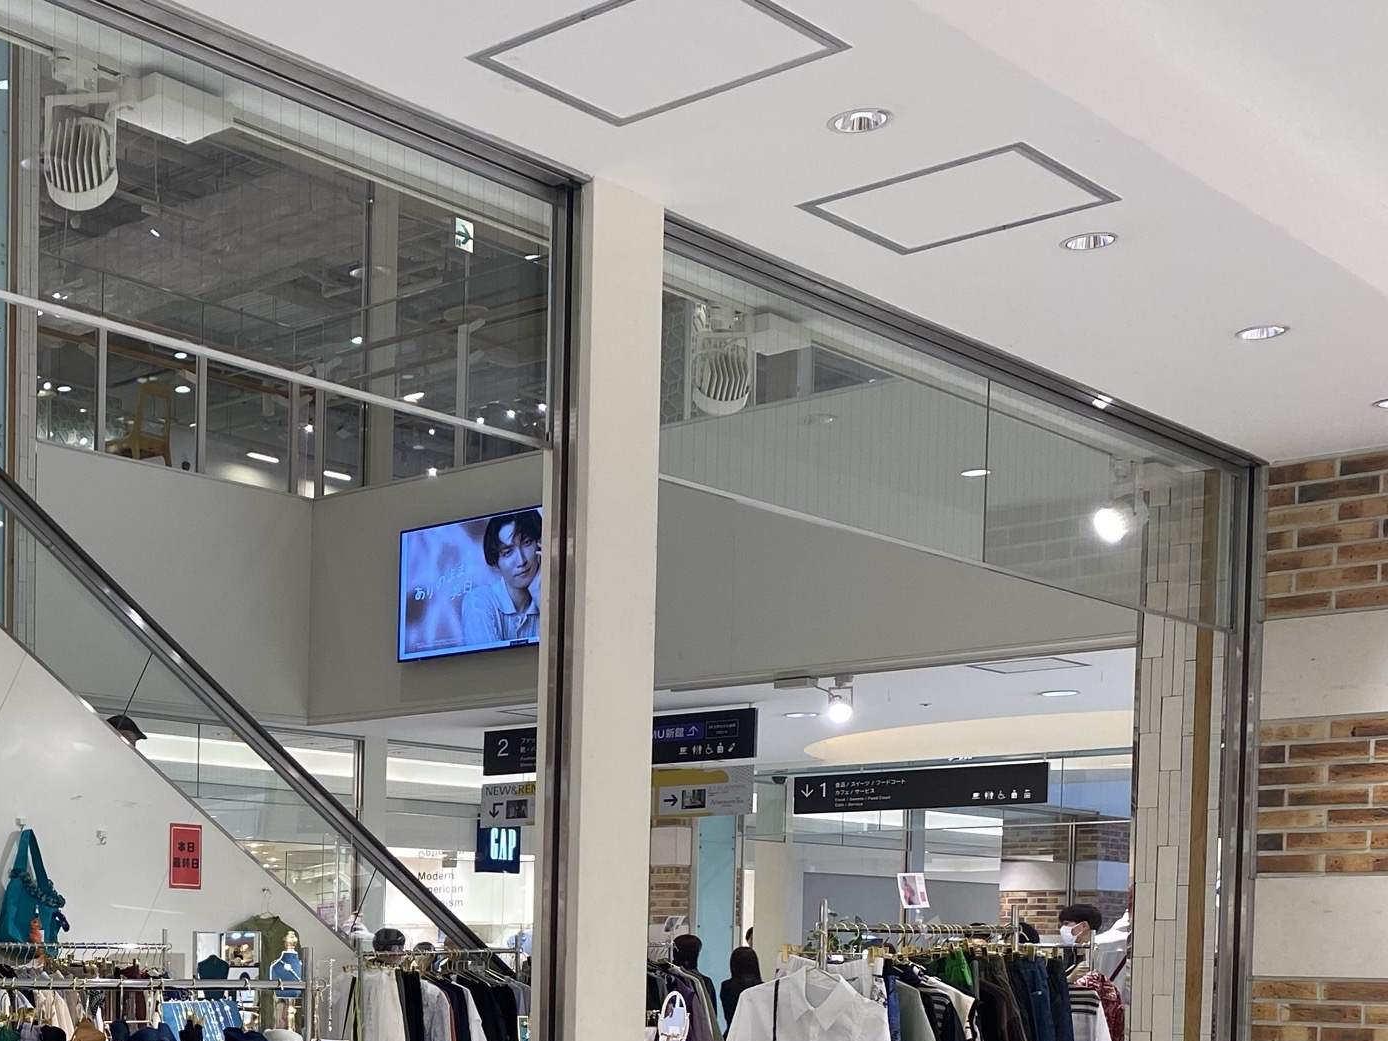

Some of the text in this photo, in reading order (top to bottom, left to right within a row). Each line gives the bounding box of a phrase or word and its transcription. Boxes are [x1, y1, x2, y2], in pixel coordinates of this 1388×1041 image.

[497, 738, 509, 757] 2
[820, 783, 827, 798] 1
[177, 841, 195, 853] 本日
[490, 827, 517, 861] GAP
[172, 857, 200, 869] 最終日
[418, 871, 455, 881] Modern
